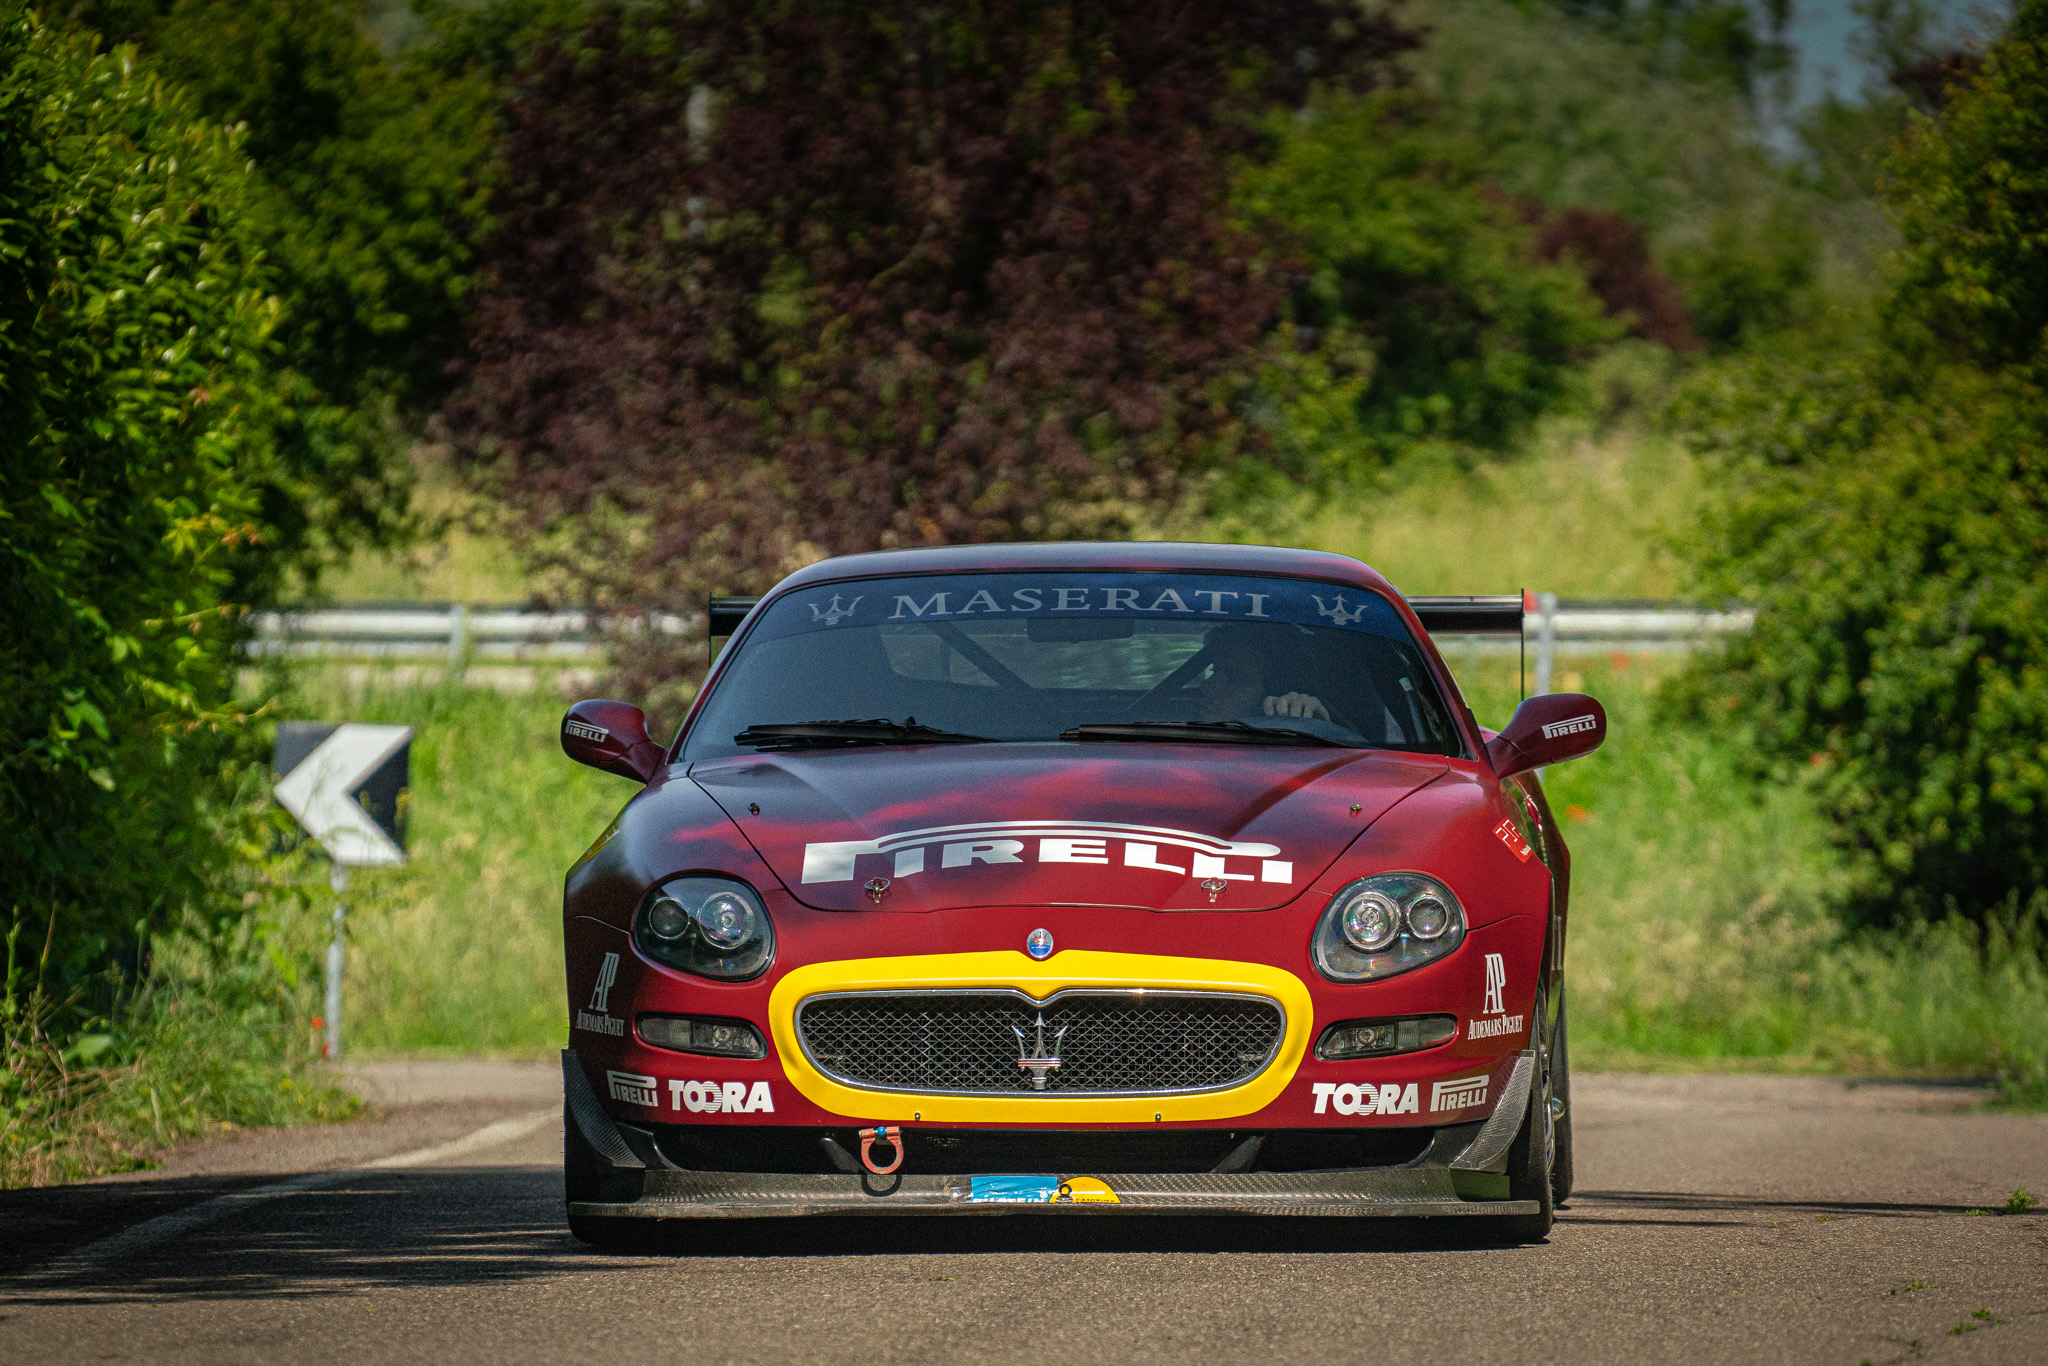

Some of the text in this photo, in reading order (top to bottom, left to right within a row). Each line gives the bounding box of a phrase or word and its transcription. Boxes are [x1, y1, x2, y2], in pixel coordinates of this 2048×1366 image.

[887, 588, 1270, 618] MASERATI
[564, 719, 609, 743] PIRELLI
[1541, 714, 1597, 739] PIRELLI
[801, 820, 1293, 884] PIRELLI
[588, 953, 620, 1012] AP
[1482, 953, 1506, 1014] AP
[1467, 1014, 1523, 1040] AUDEMARS PIGUET
[606, 1069, 659, 1107] PIRELLI
[668, 1079, 775, 1113] TOORA
[1312, 1082, 1419, 1116] TOORA
[1429, 1074, 1490, 1112] PIRELLI
